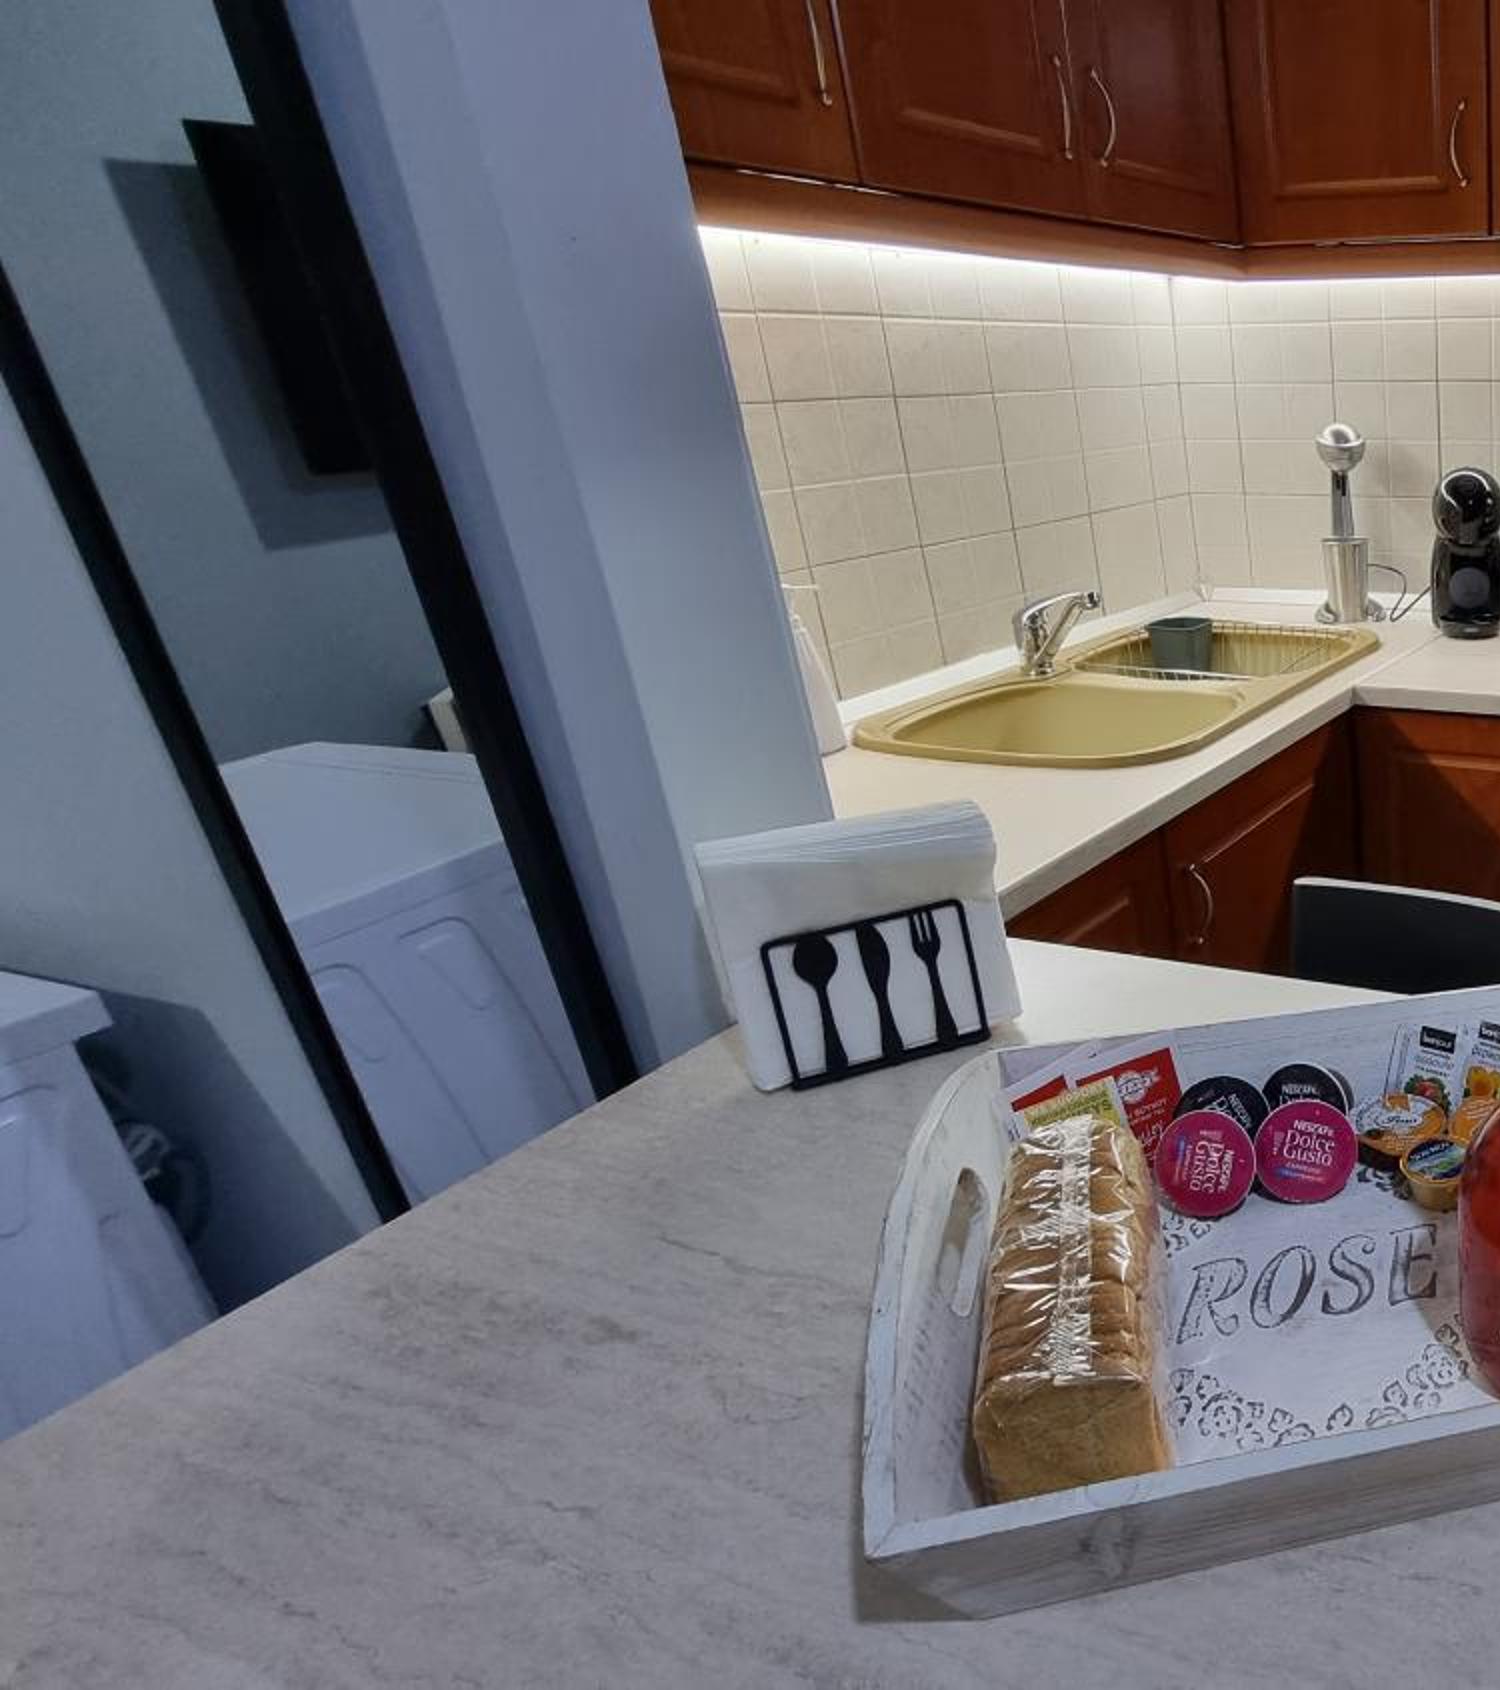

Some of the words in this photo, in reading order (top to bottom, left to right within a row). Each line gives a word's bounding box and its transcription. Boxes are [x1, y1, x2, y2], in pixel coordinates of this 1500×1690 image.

[1285, 1129, 1336, 1152] Dolce
[1189, 1141, 1209, 1192] Gusto
[1283, 1143, 1333, 1167] Gusto
